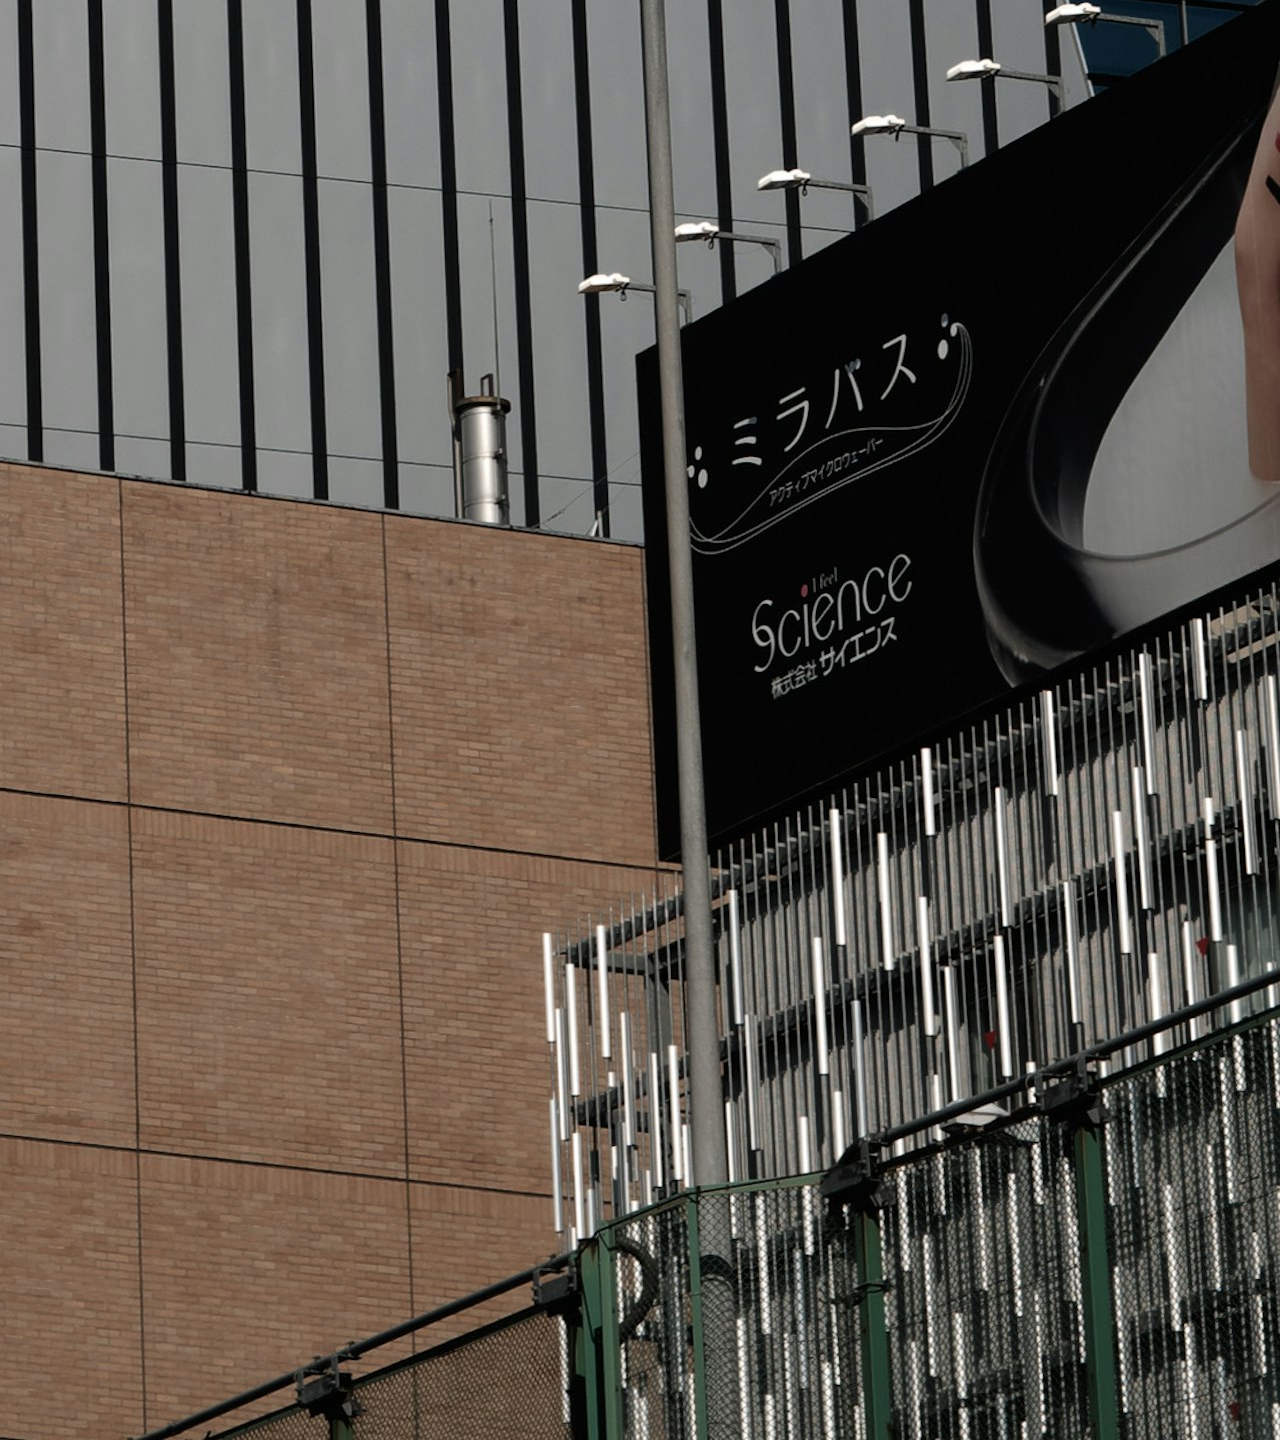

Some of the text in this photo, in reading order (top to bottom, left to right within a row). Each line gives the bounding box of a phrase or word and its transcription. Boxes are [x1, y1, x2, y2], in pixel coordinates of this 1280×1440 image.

[731, 333, 917, 466] ミラバス
[751, 553, 913, 673] Science
[771, 616, 898, 700] 株式会社 サイエンス
